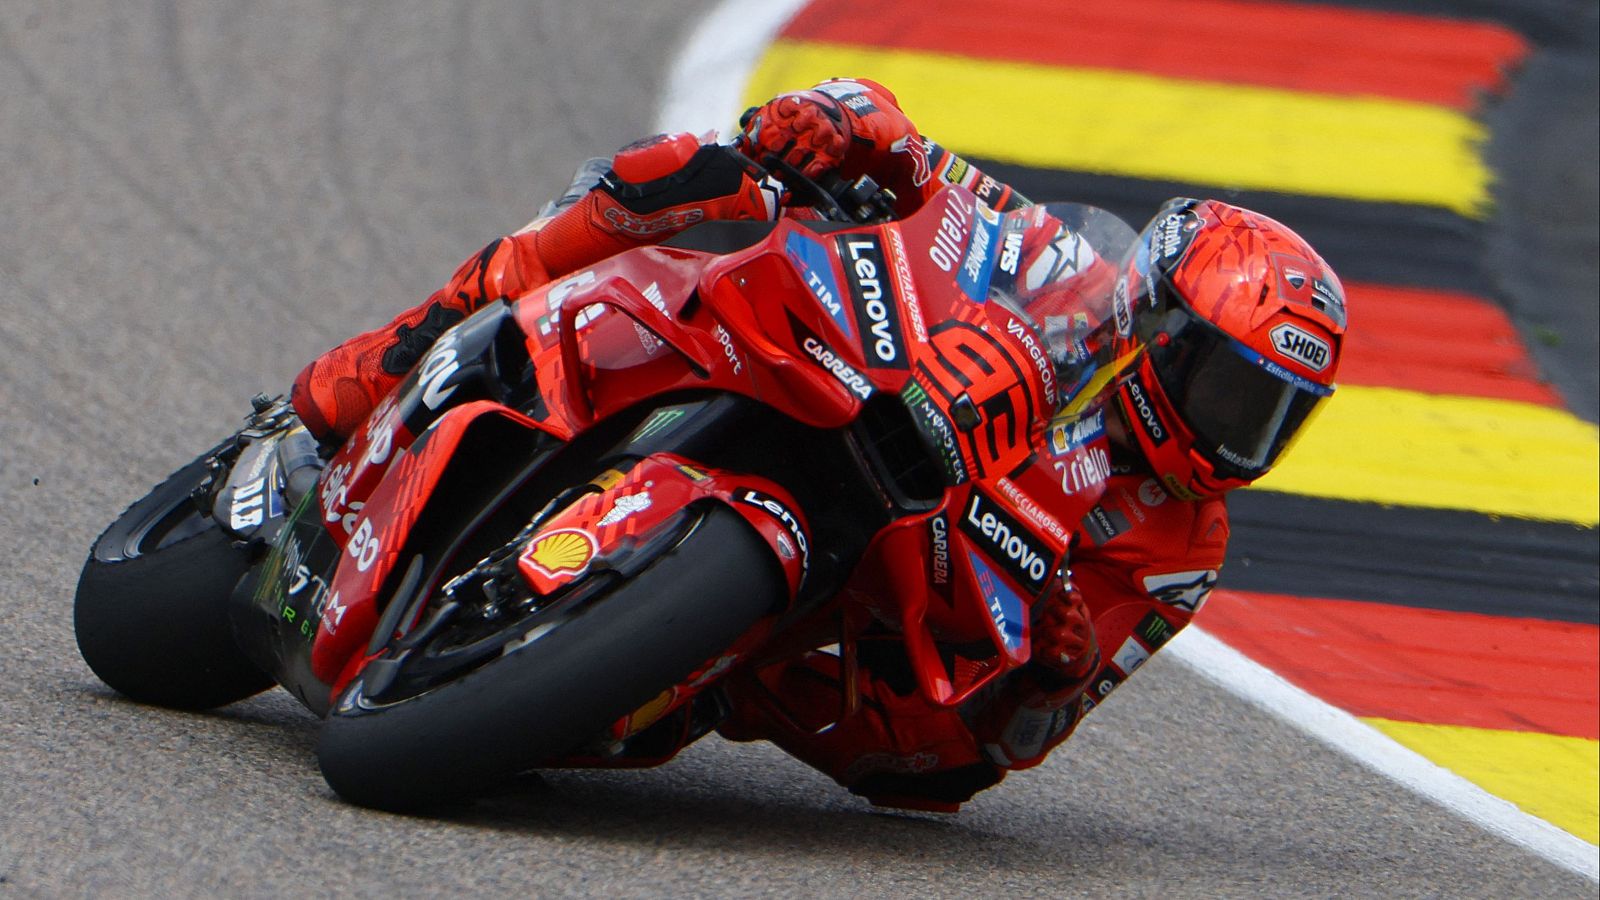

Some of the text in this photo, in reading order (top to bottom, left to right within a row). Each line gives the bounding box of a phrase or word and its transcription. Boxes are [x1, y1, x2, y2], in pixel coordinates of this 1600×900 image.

[889, 228, 929, 343] FRECCIAROSSA
[1000, 231, 1024, 275] WRS
[808, 271, 842, 317] TIM
[848, 241, 897, 362] Lenovo
[803, 337, 873, 400] CARRERA
[1280, 330, 1328, 369] SHOEI
[921, 401, 964, 484] MONSTER
[968, 495, 1046, 581] Lenovo
[997, 477, 1070, 546] FRECCIAROSSA
[931, 516, 948, 585] CARRERA
